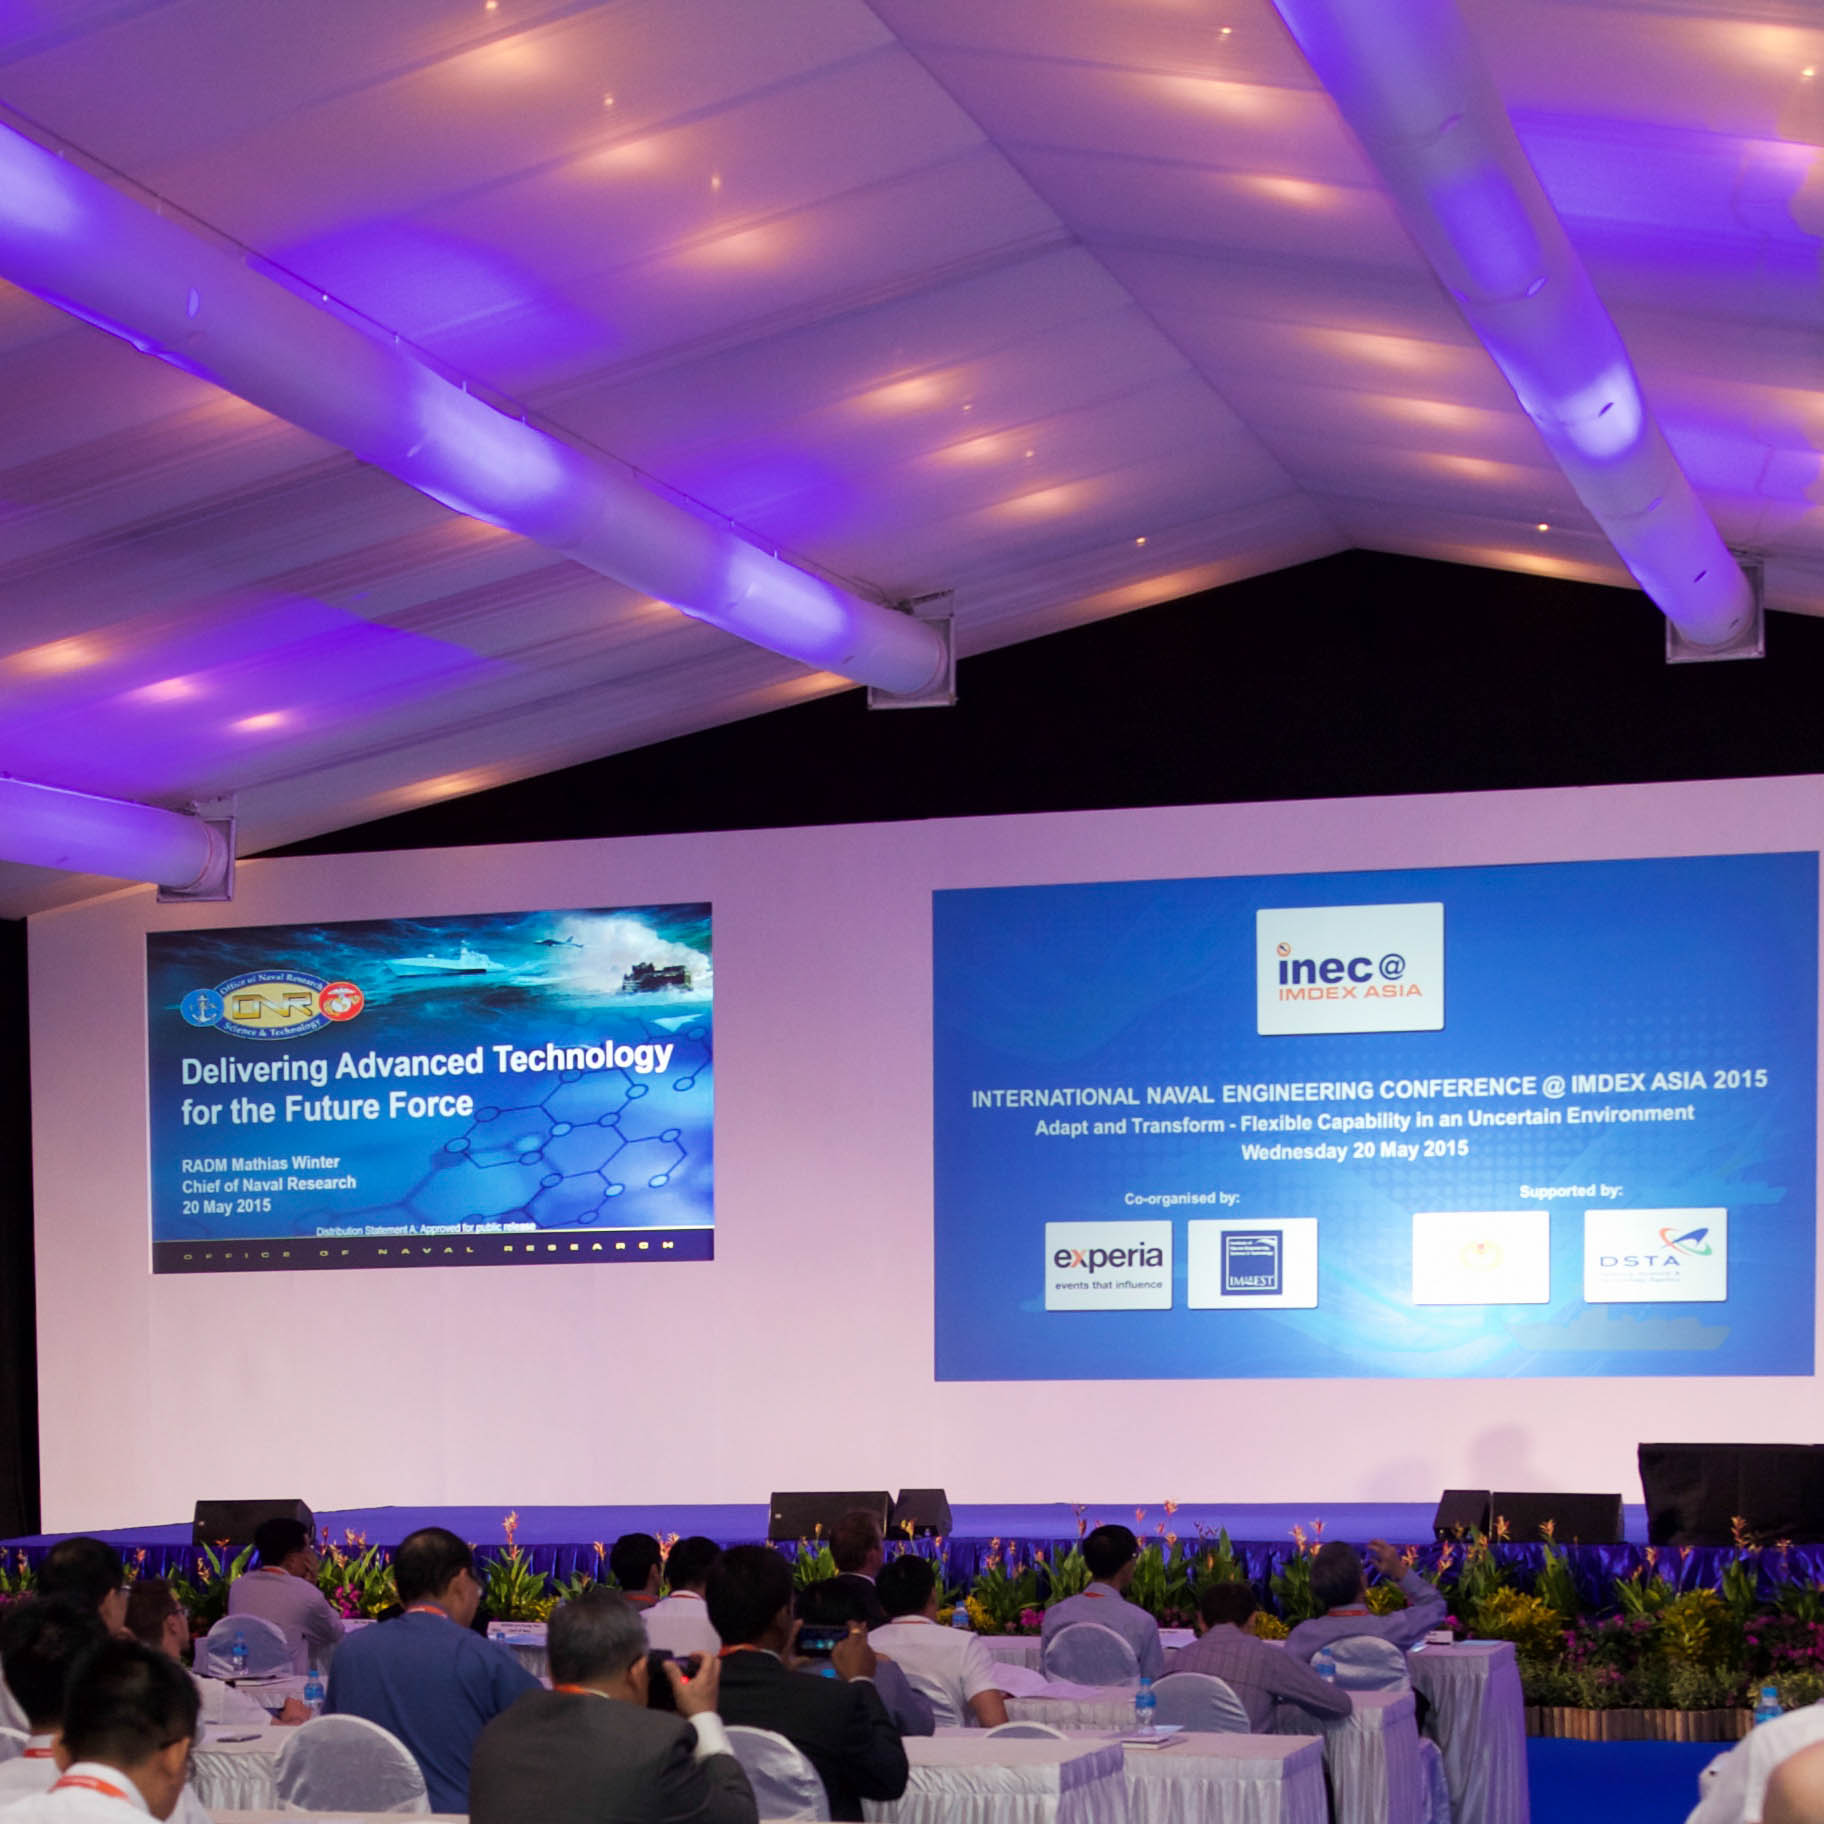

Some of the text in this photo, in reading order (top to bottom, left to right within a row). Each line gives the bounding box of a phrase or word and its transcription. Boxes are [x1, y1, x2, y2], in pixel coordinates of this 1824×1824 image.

[1279, 983, 1422, 1001] IMDEX ASIA
[182, 1040, 674, 1087] Delivering Advanced Technology
[971, 1069, 1768, 1109] INTERNATIONAL NAVAL ENGINEERING CONFERENCE @ IMDEX ASIA 2015
[181, 1091, 473, 1126] for the Future Force
[1034, 1119, 1089, 1138] Adapt
[1093, 1118, 1127, 1135] and
[1131, 1117, 1225, 1135] Transform
[1240, 1114, 1312, 1132] Flexible
[1317, 1112, 1410, 1134] Capability
[1415, 1110, 1435, 1128] in
[1438, 1112, 1463, 1128] an
[1468, 1107, 1562, 1127] Uncertain
[1566, 1104, 1695, 1125] Environment
[1241, 1139, 1470, 1163] Wednesday 20 May 2015
[182, 1155, 341, 1173] RADM Mathias Winter
[182, 1174, 357, 1194] Chief of Naval Research
[1519, 1184, 1623, 1200] Supported by:
[182, 1198, 272, 1217] 20 May 2015
[1124, 1191, 1241, 1207] Co-organised by:
[1054, 1242, 1164, 1274] experia
[1600, 1255, 1681, 1267] DSTA
[1055, 1280, 1163, 1290] events that influence
